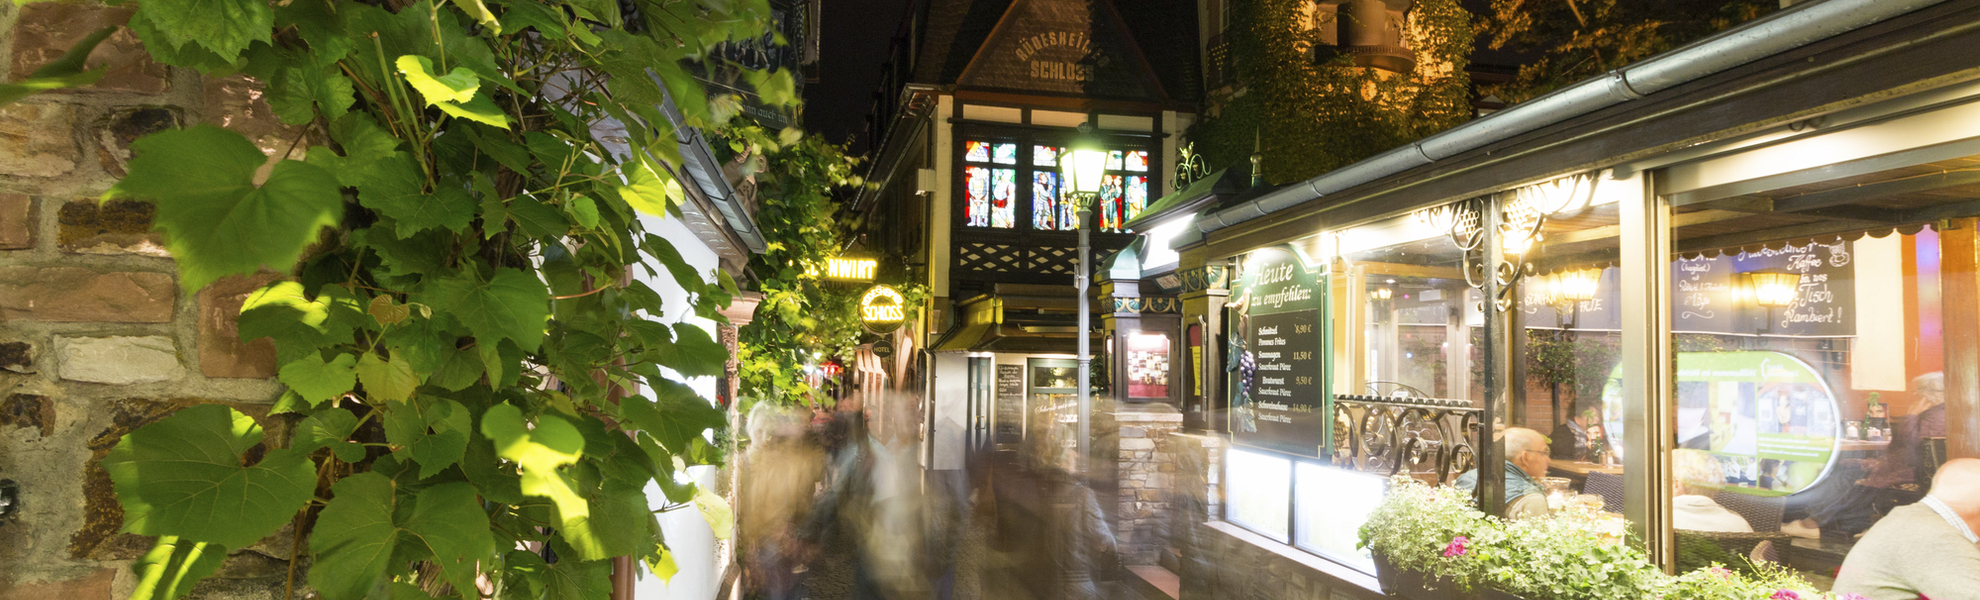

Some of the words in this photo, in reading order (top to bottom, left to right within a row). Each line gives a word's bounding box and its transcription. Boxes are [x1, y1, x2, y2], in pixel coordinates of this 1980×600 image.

[1030, 60, 1094, 81] SCHLOSS
[1786, 254, 1822, 273] Kaffee
[1251, 262, 1294, 287] Heute
[1251, 294, 1262, 307] zu
[1263, 284, 1312, 309] empfehlen:
[1798, 284, 1834, 308] Tisch
[862, 305, 904, 321] SCHLOSS
[873, 345, 891, 354] HOTEL
